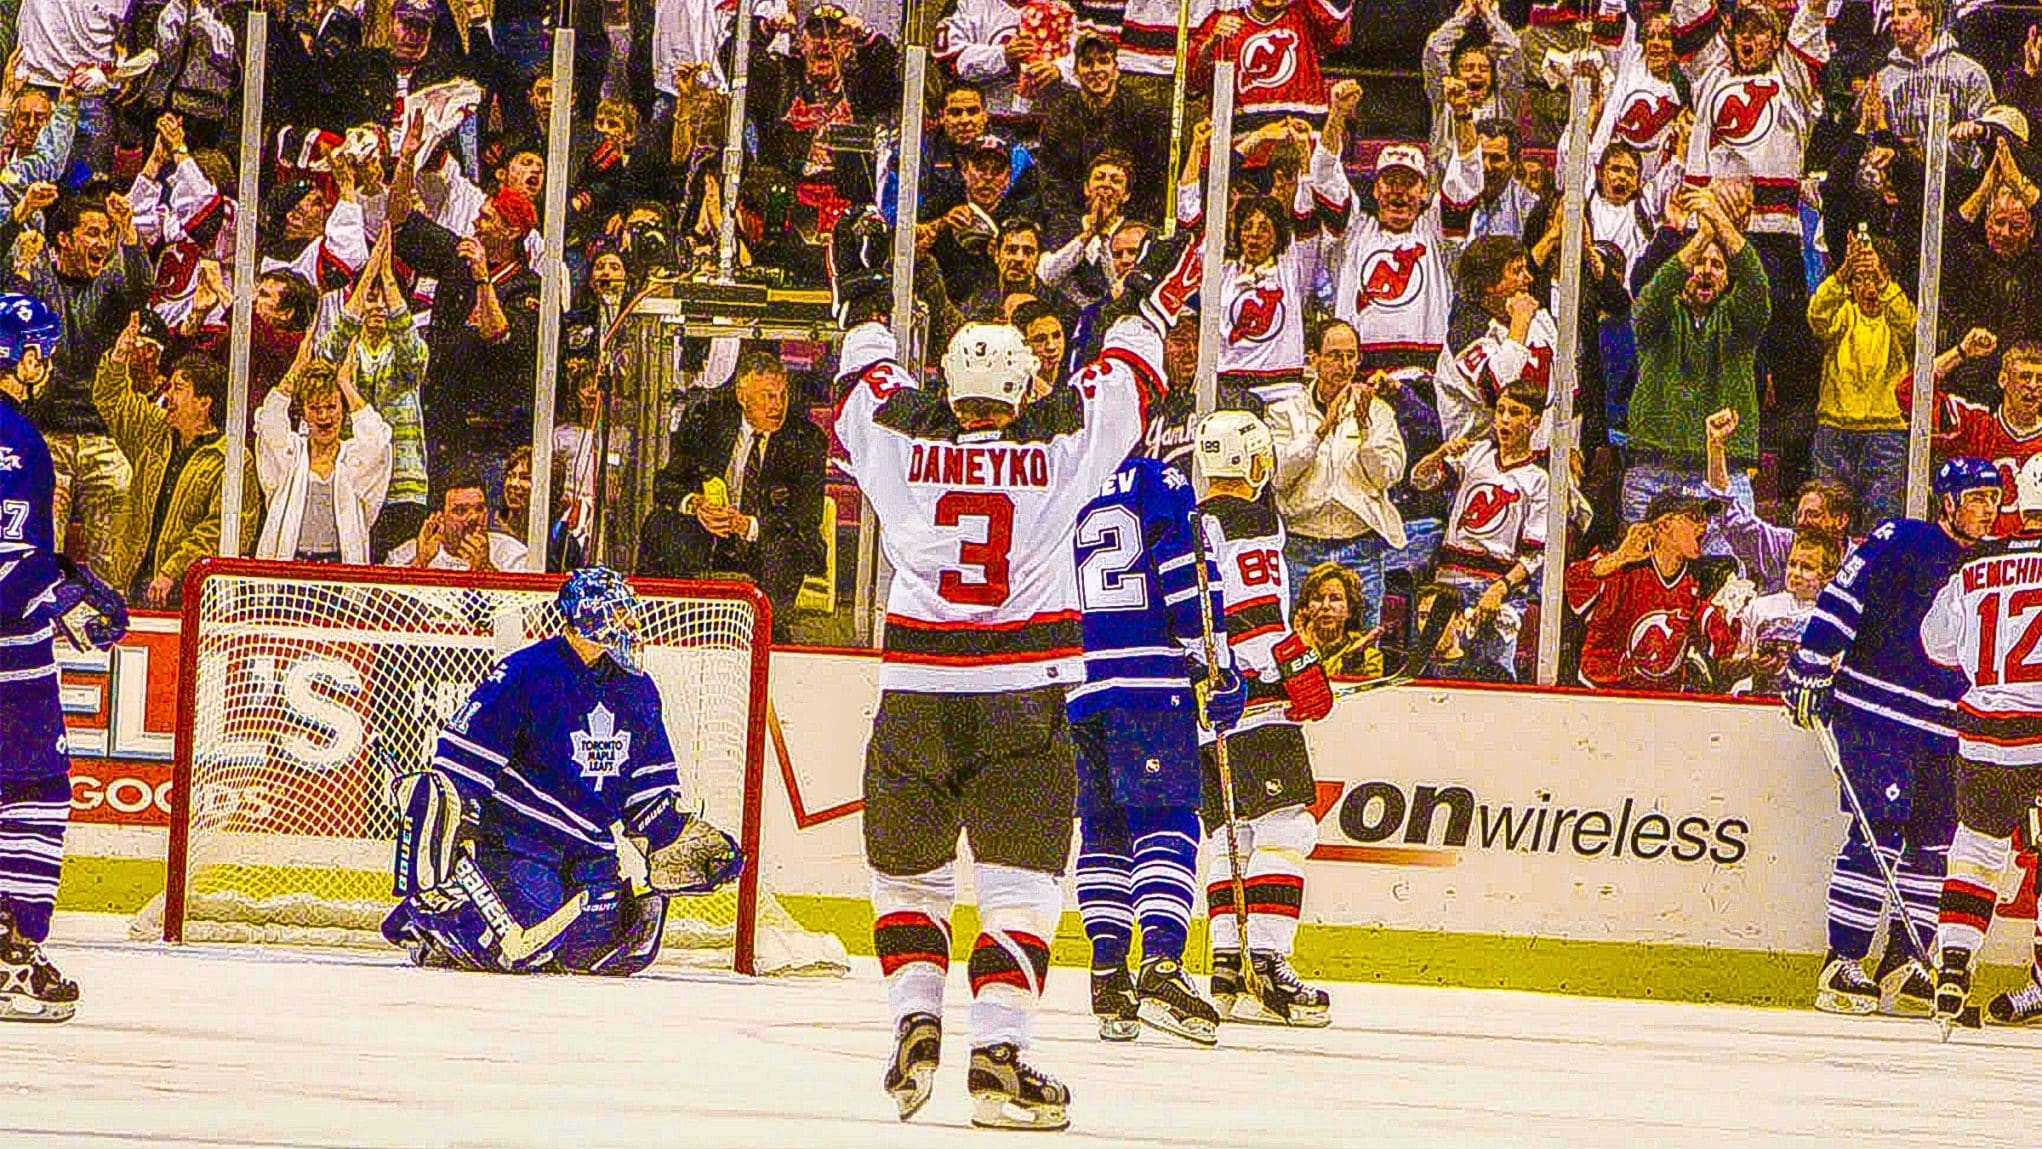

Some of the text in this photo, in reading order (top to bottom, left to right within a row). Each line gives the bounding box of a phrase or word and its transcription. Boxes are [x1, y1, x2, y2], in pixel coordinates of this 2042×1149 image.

[975, 341, 987, 357] 3
[908, 443, 1049, 487] DANEYKO
[1101, 467, 1137, 496] EV
[0, 499, 29, 540] 7
[934, 490, 1016, 607] 3
[1076, 504, 1148, 613] 2
[1974, 588, 2042, 687] 12
[581, 740, 624, 751] TORONTO
[588, 751, 616, 761] MAPLE
[589, 761, 614, 772] LEAFS
[1479, 793, 1750, 865] wireless
